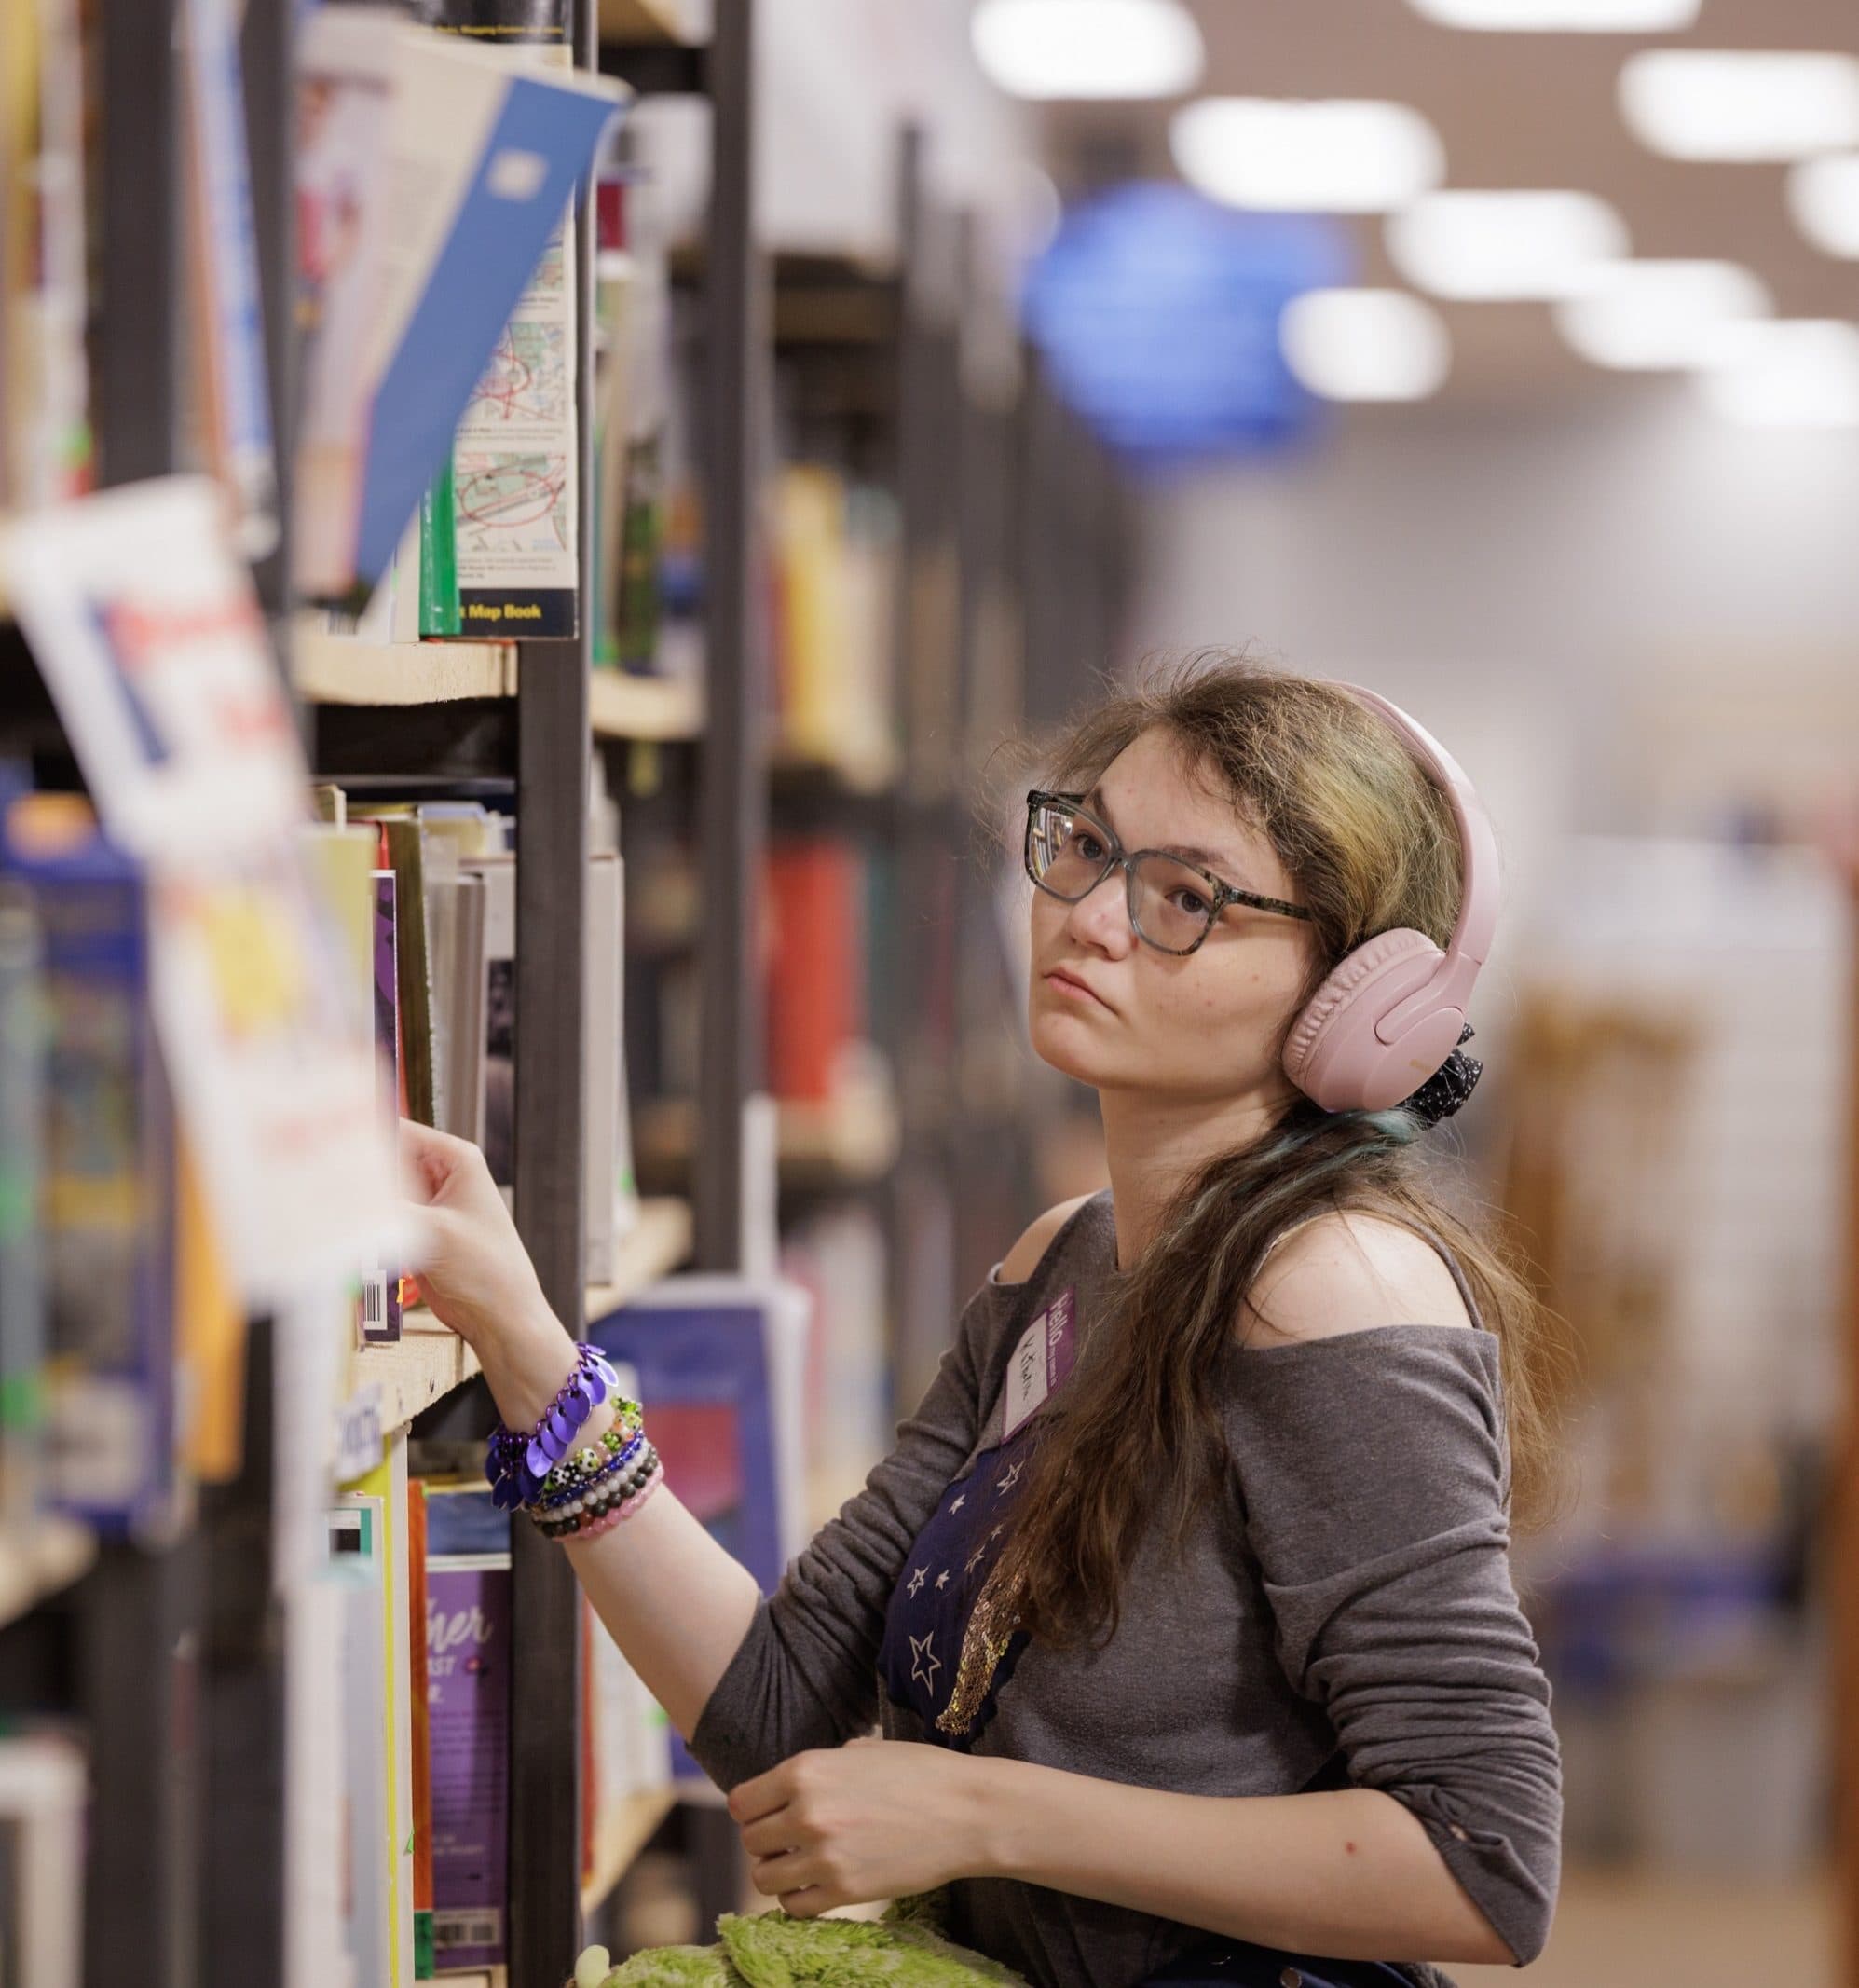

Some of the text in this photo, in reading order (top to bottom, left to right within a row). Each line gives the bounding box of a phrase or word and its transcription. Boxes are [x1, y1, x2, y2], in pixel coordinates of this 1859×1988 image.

[469, 604, 501, 622] Map
[504, 603, 541, 620] Book
[1049, 1292, 1069, 1347] Hello
